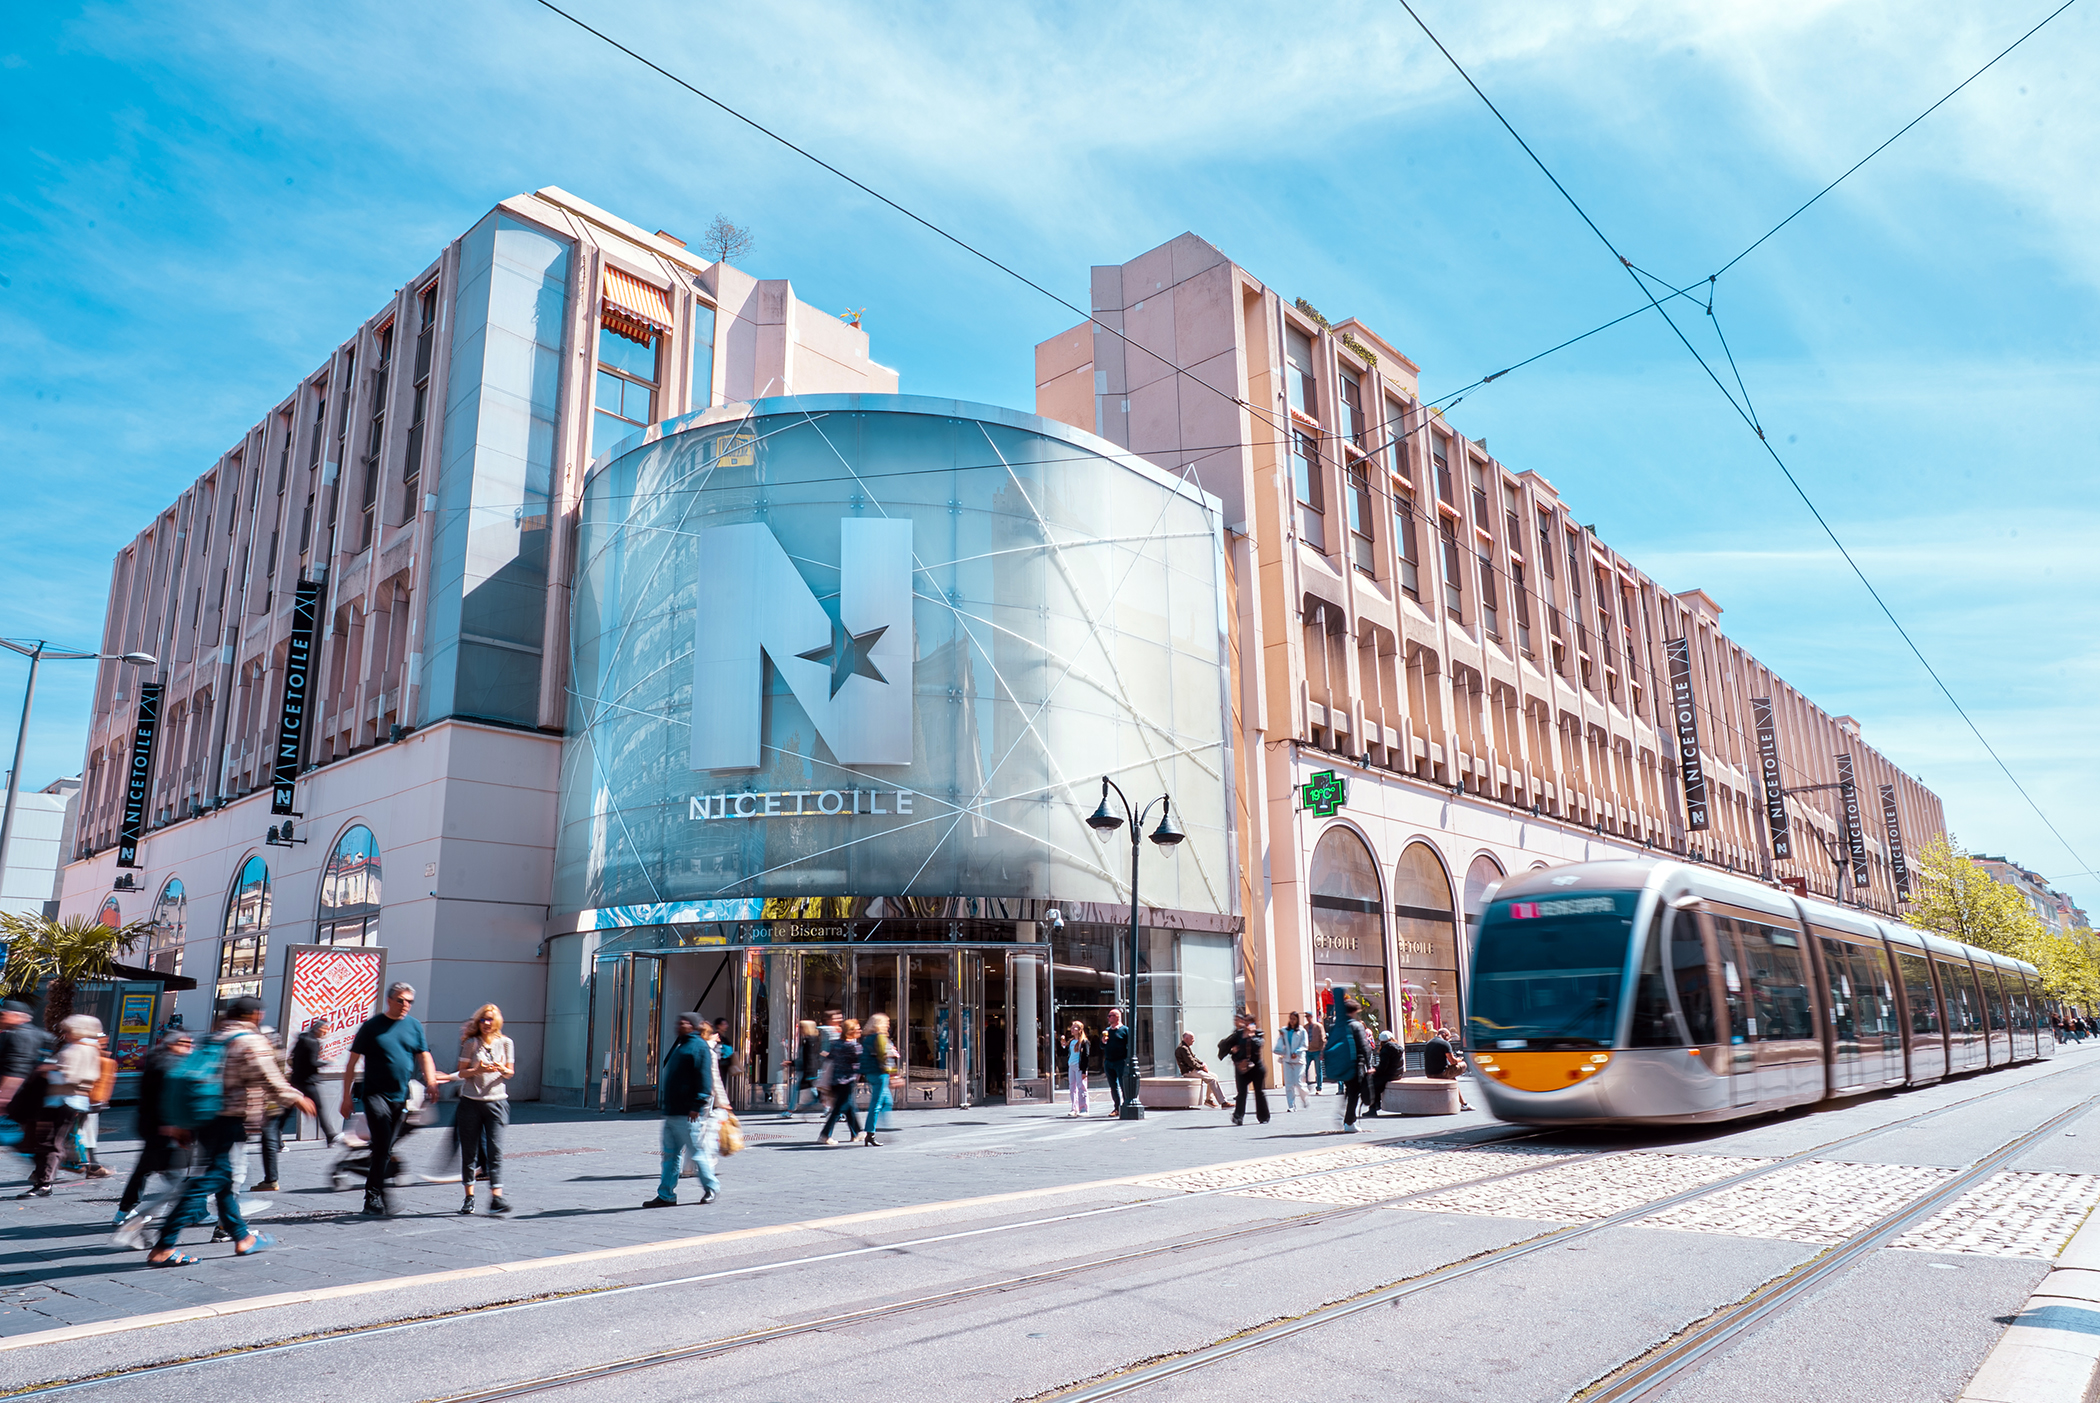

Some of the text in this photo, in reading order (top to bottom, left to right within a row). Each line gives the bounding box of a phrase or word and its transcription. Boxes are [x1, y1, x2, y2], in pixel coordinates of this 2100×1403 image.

[690, 517, 913, 772] N
[280, 638, 309, 758] NICETOILE
[1675, 681, 1700, 782] NICETOILE
[126, 728, 152, 823] NICETOILE
[689, 789, 914, 820] NICETOILE
[1761, 734, 1783, 819] NICETOILE
[1886, 811, 1904, 873] NICETOILE
[752, 924, 843, 940] porte Biscarra
[324, 1039, 342, 1050] AVRIL
